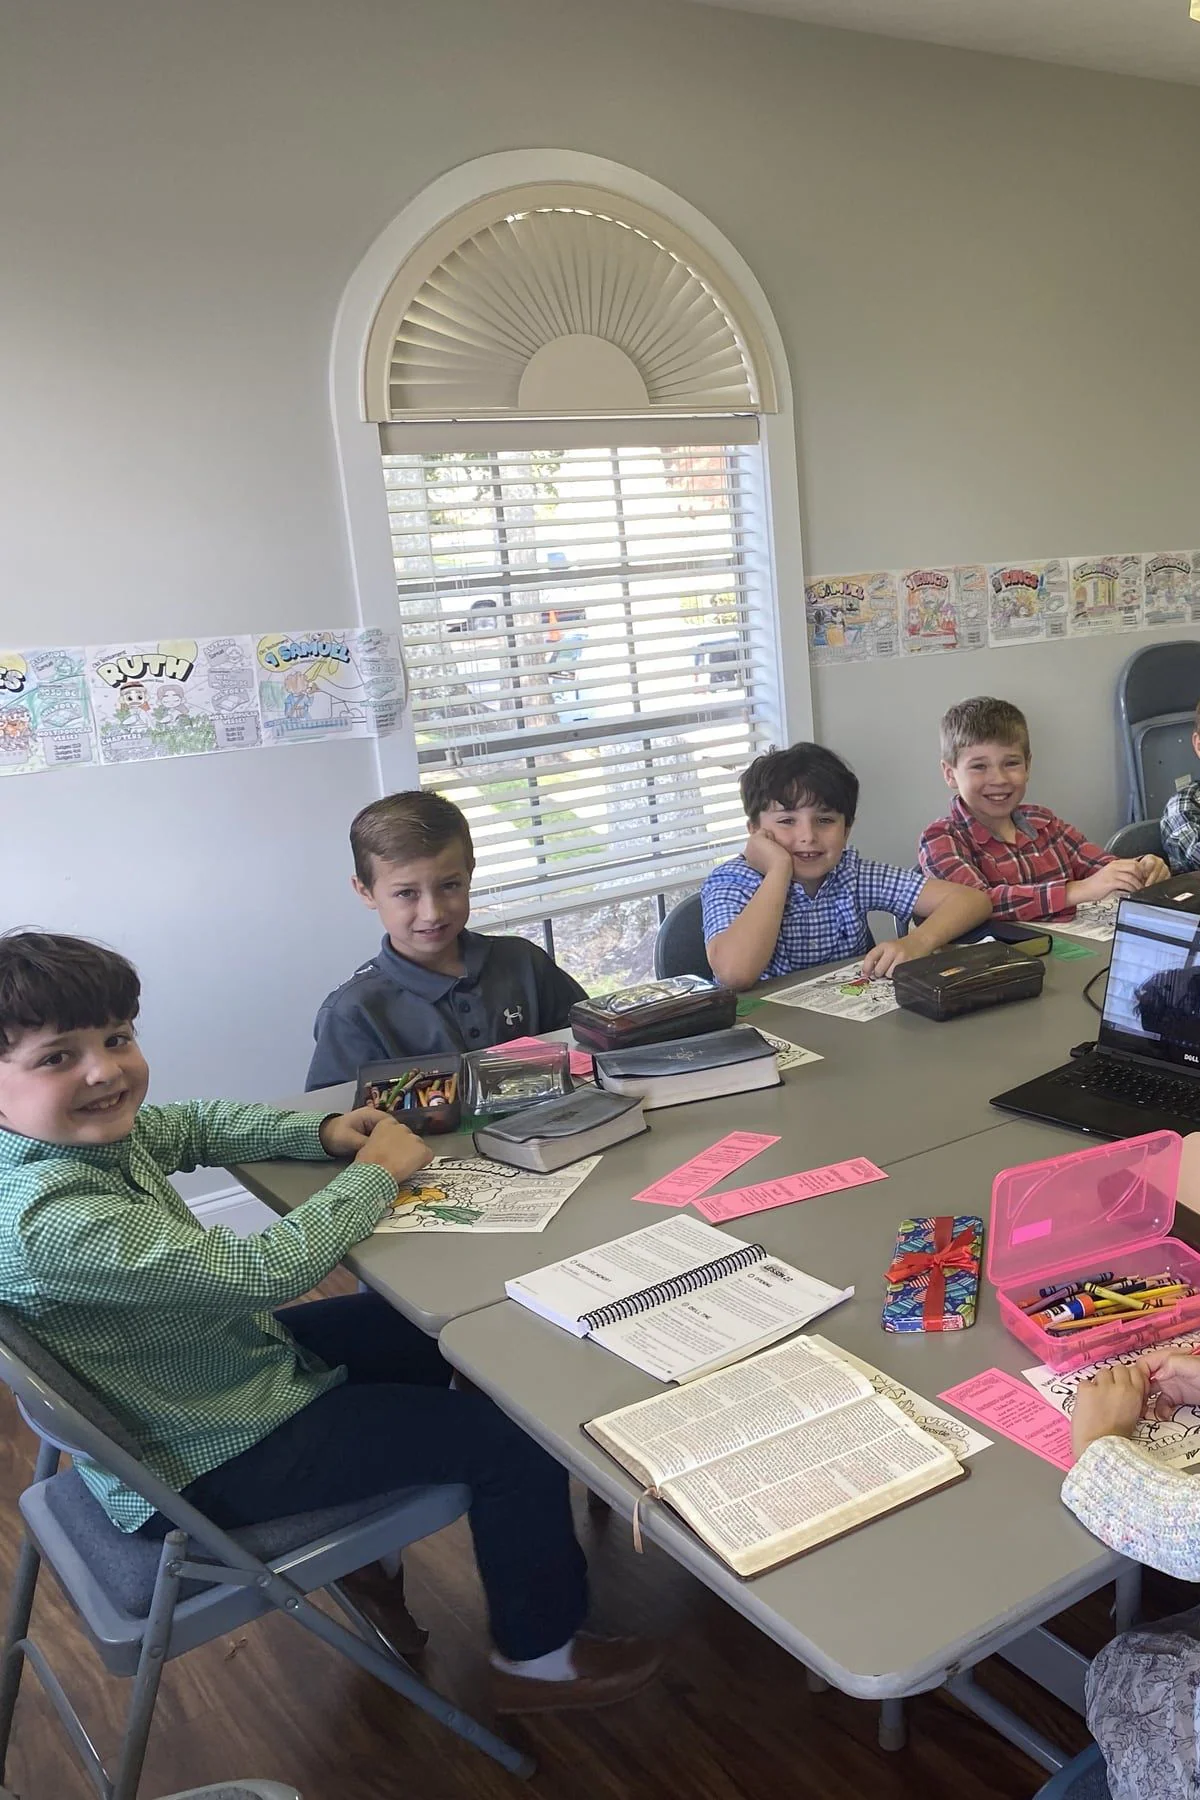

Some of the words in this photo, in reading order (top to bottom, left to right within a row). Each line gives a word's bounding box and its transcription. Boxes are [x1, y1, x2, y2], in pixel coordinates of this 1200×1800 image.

[815, 581, 865, 601] SAMUEL
[278, 640, 351, 664] SAMUEL
[96, 654, 194, 688] RUTH
[1184, 1053, 1199, 1064] DELL
[915, 1415, 970, 1439] AUTHOR
